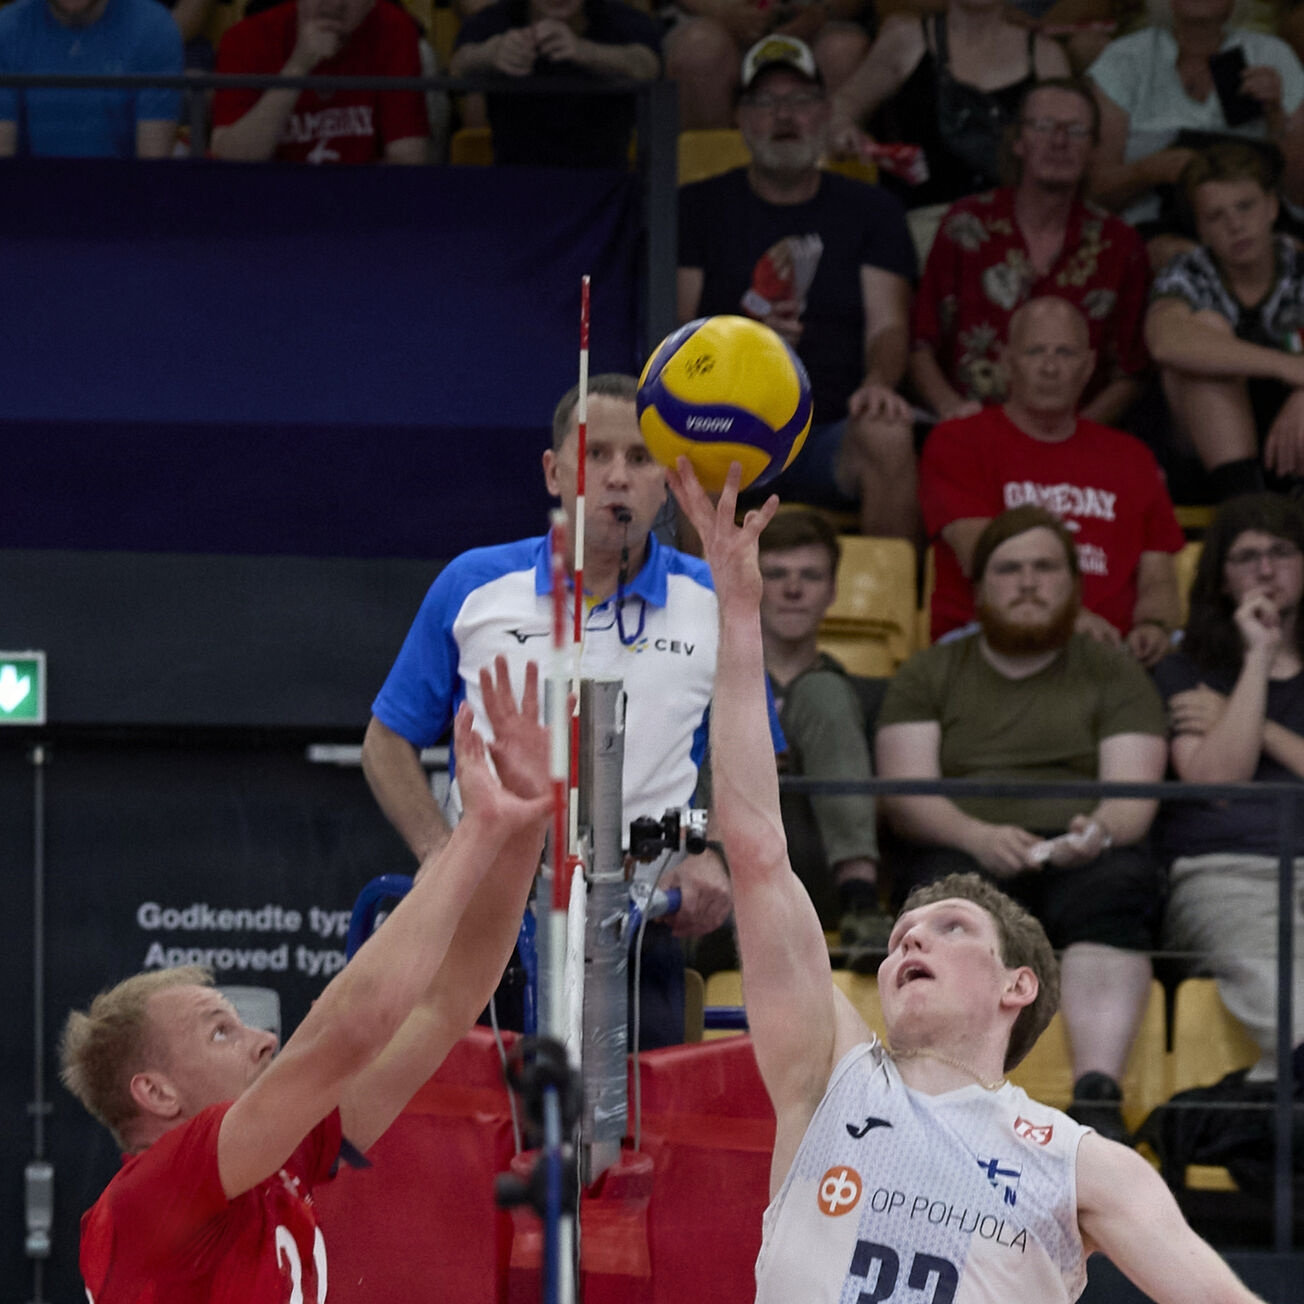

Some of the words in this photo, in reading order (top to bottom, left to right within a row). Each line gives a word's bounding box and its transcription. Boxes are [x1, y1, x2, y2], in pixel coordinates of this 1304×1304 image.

[654, 638, 695, 656] CEV
[136, 901, 303, 933] Godkendte
[145, 941, 289, 972] Approved
[870, 1187, 905, 1215] OP
[909, 1195, 1028, 1254] POHJOLA
